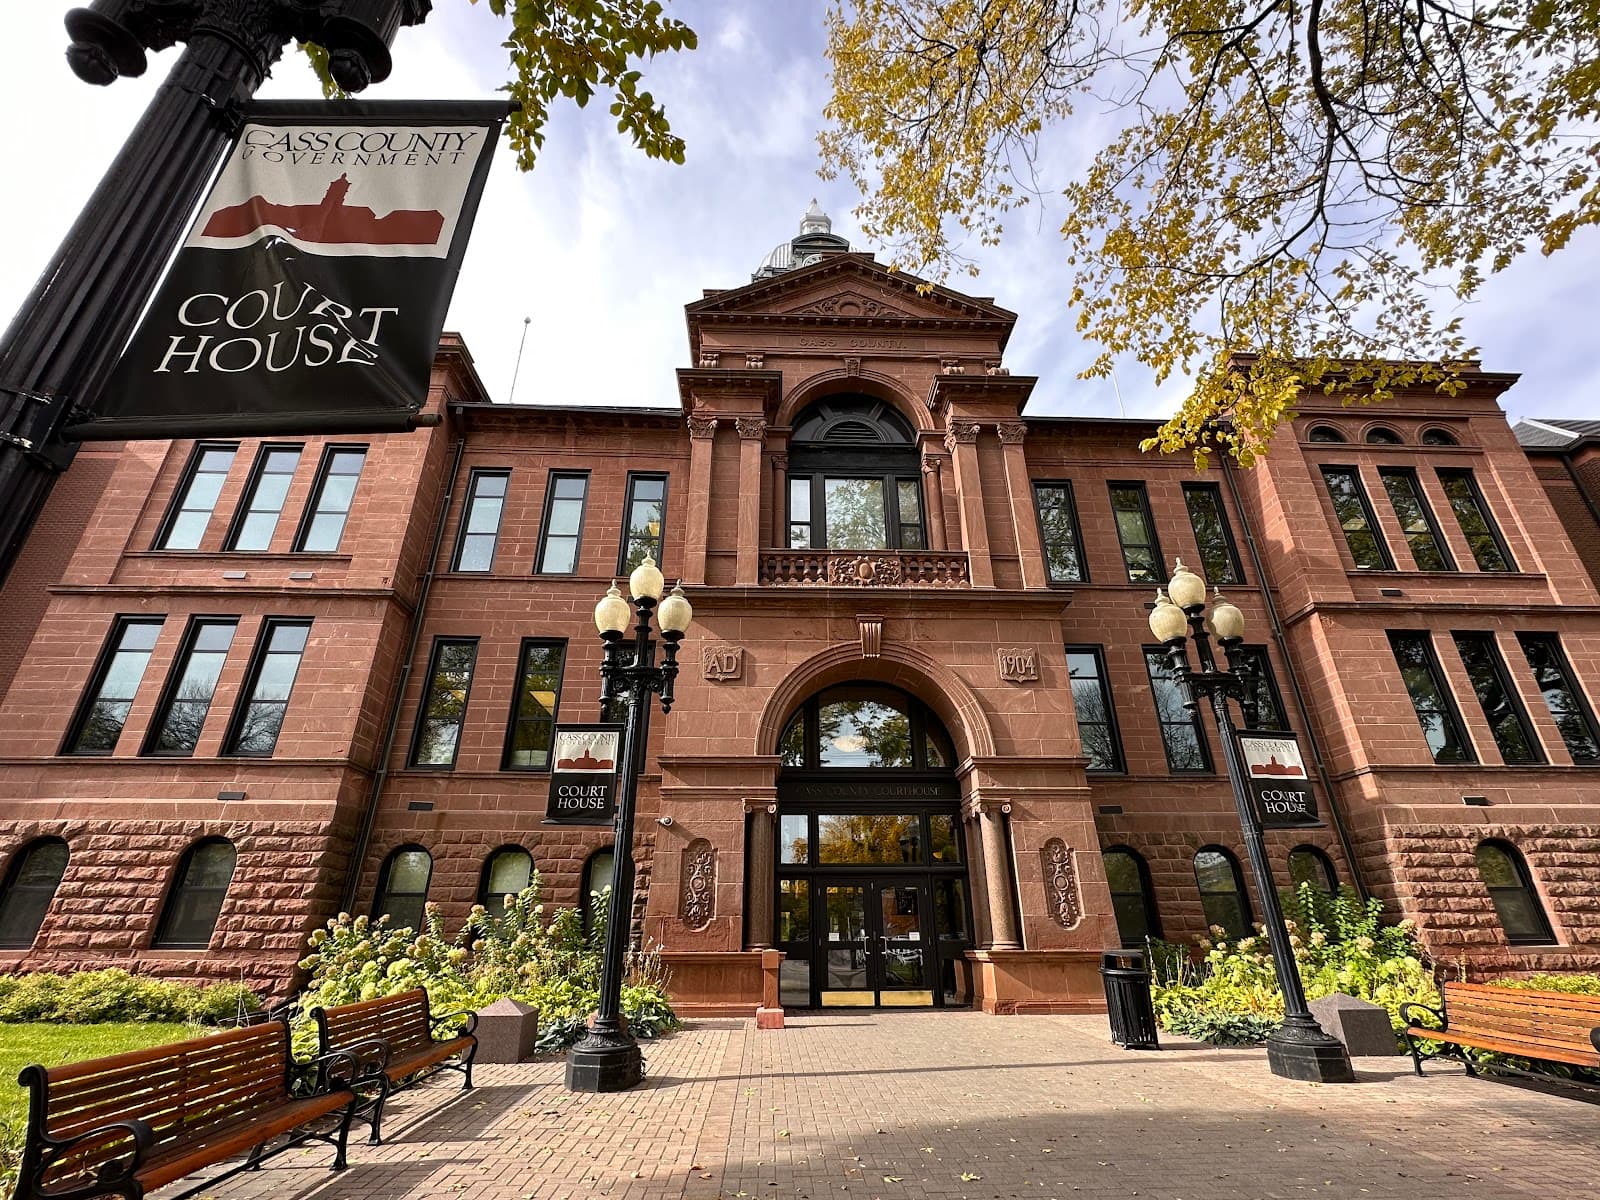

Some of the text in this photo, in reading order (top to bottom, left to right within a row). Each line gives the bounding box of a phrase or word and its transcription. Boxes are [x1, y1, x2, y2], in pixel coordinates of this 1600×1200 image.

[246, 130, 478, 153] CASS COUNTY
[242, 145, 466, 166] GOVERNMENT
[178, 281, 399, 347] COURT
[153, 325, 379, 373] HOUSE
[800, 338, 837, 347] CASS
[705, 653, 738, 673] AD
[1001, 655, 1036, 675] 1904
[559, 733, 617, 741] CASS COUNTY
[558, 785, 607, 797] COURT
[871, 785, 942, 796] COURTHOUSE
[1261, 790, 1306, 802] COURT
[557, 797, 605, 809] HOUSE
